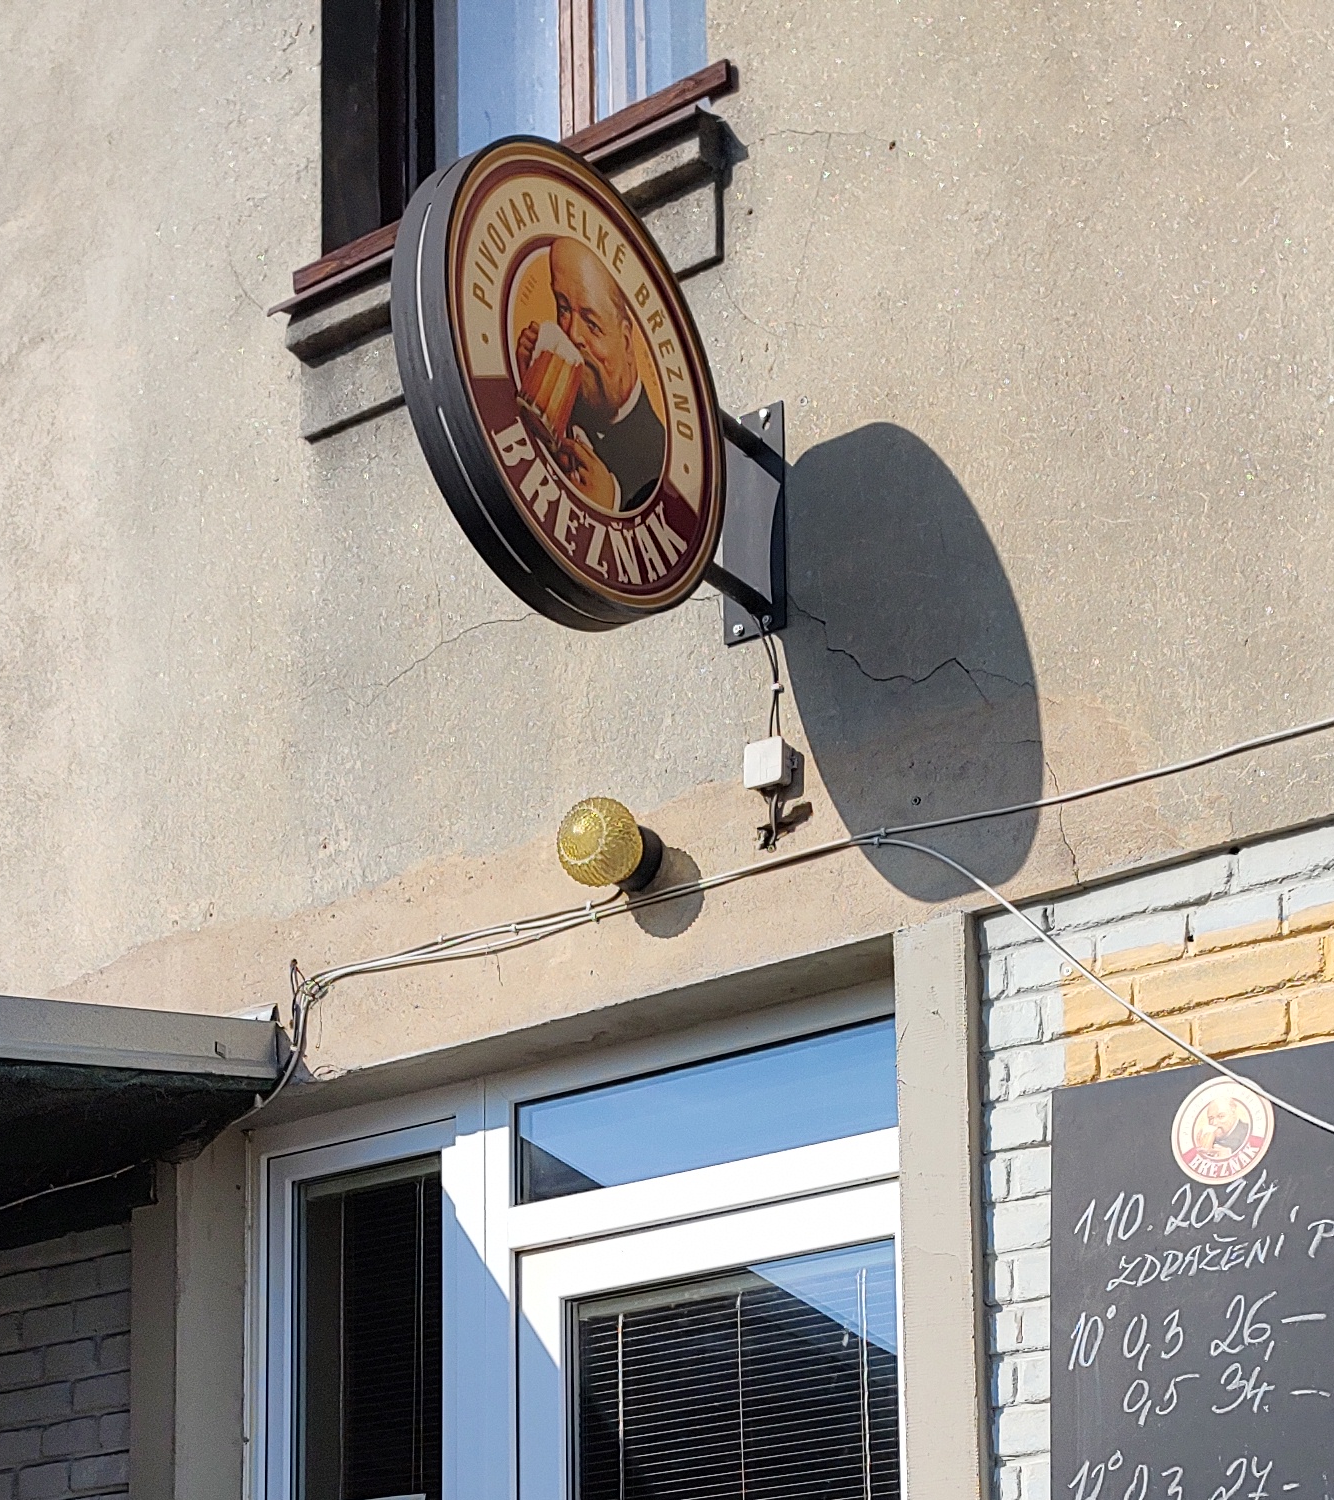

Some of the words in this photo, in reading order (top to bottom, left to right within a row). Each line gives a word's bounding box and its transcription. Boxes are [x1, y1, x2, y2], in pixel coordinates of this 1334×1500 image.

[472, 191, 540, 310] PIVOVAR
[548, 191, 626, 275] VELKÉ
[634, 282, 694, 441] BŘEZNO
[491, 416, 688, 585] BŘEZŇÁK
[1123, 1309, 1184, 1371] 0,3
[1123, 1373, 1200, 1427] 0,5
